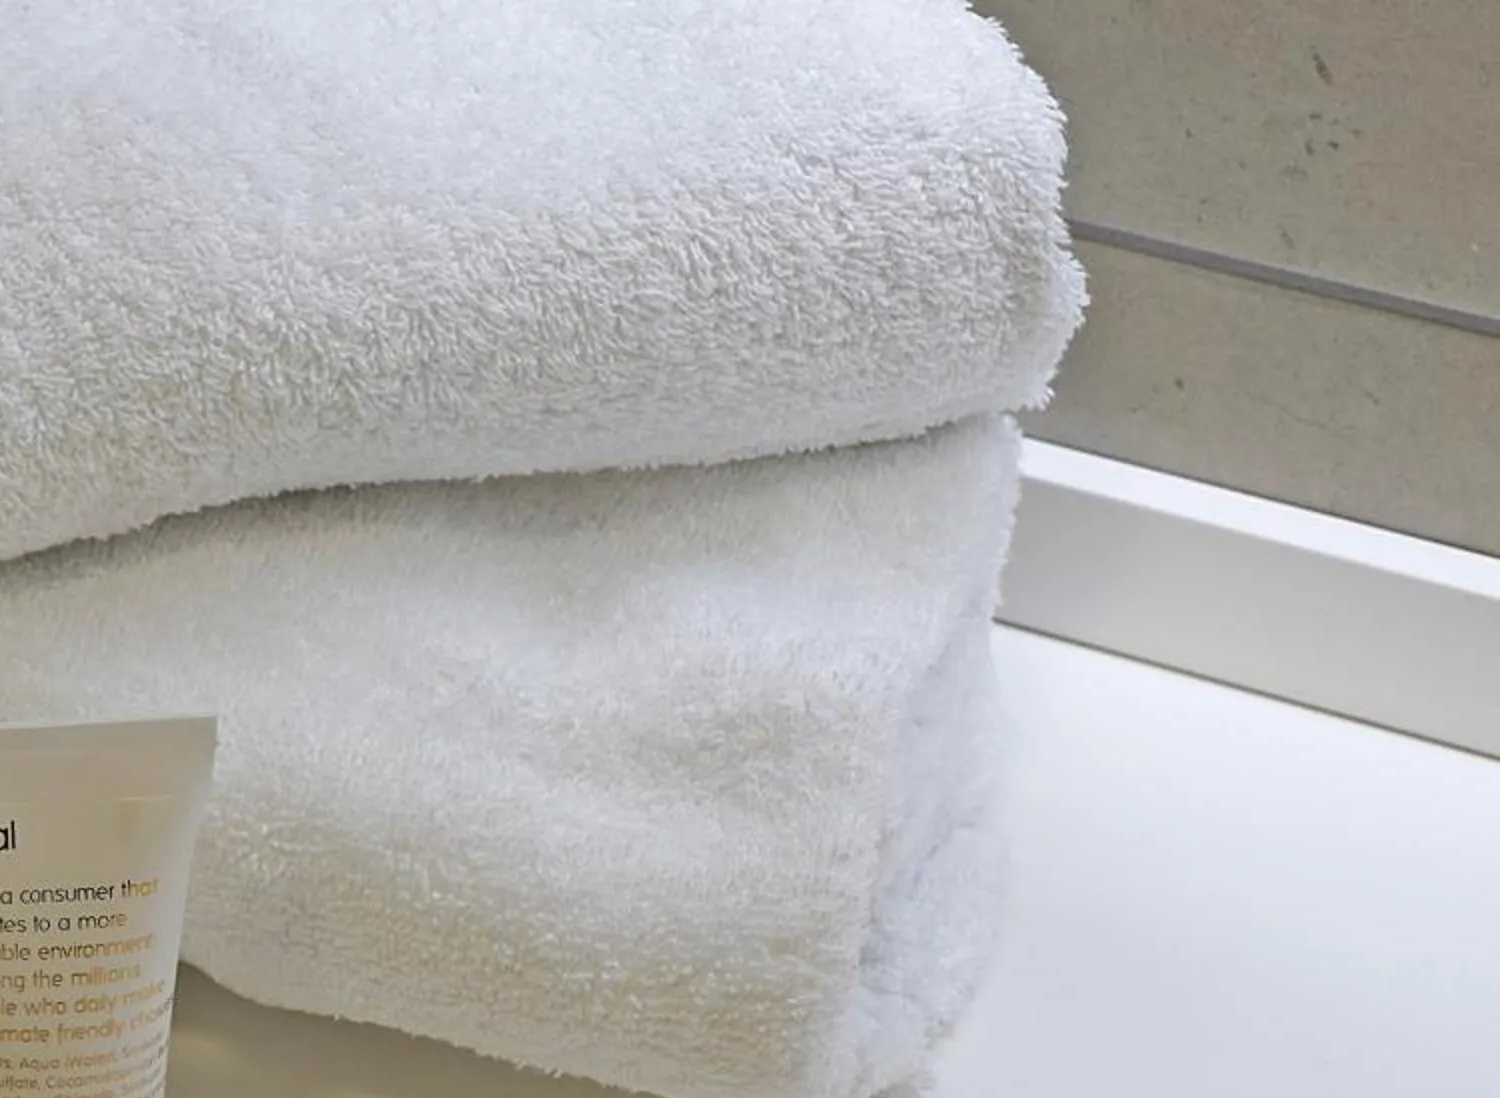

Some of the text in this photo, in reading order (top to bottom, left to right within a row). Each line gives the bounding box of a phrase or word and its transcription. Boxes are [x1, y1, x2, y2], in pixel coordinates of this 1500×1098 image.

[0, 889, 14, 905] a
[19, 883, 115, 905] consumer
[121, 878, 160, 898] that
[33, 915, 51, 933] to
[57, 917, 71, 931] a
[77, 911, 128, 930] more
[31, 968, 64, 988] the
[71, 963, 140, 988] millions
[23, 995, 67, 1016] who
[74, 992, 121, 1017] daily
[57, 1017, 125, 1046] friendly
[19, 1057, 60, 1072] Aqua
